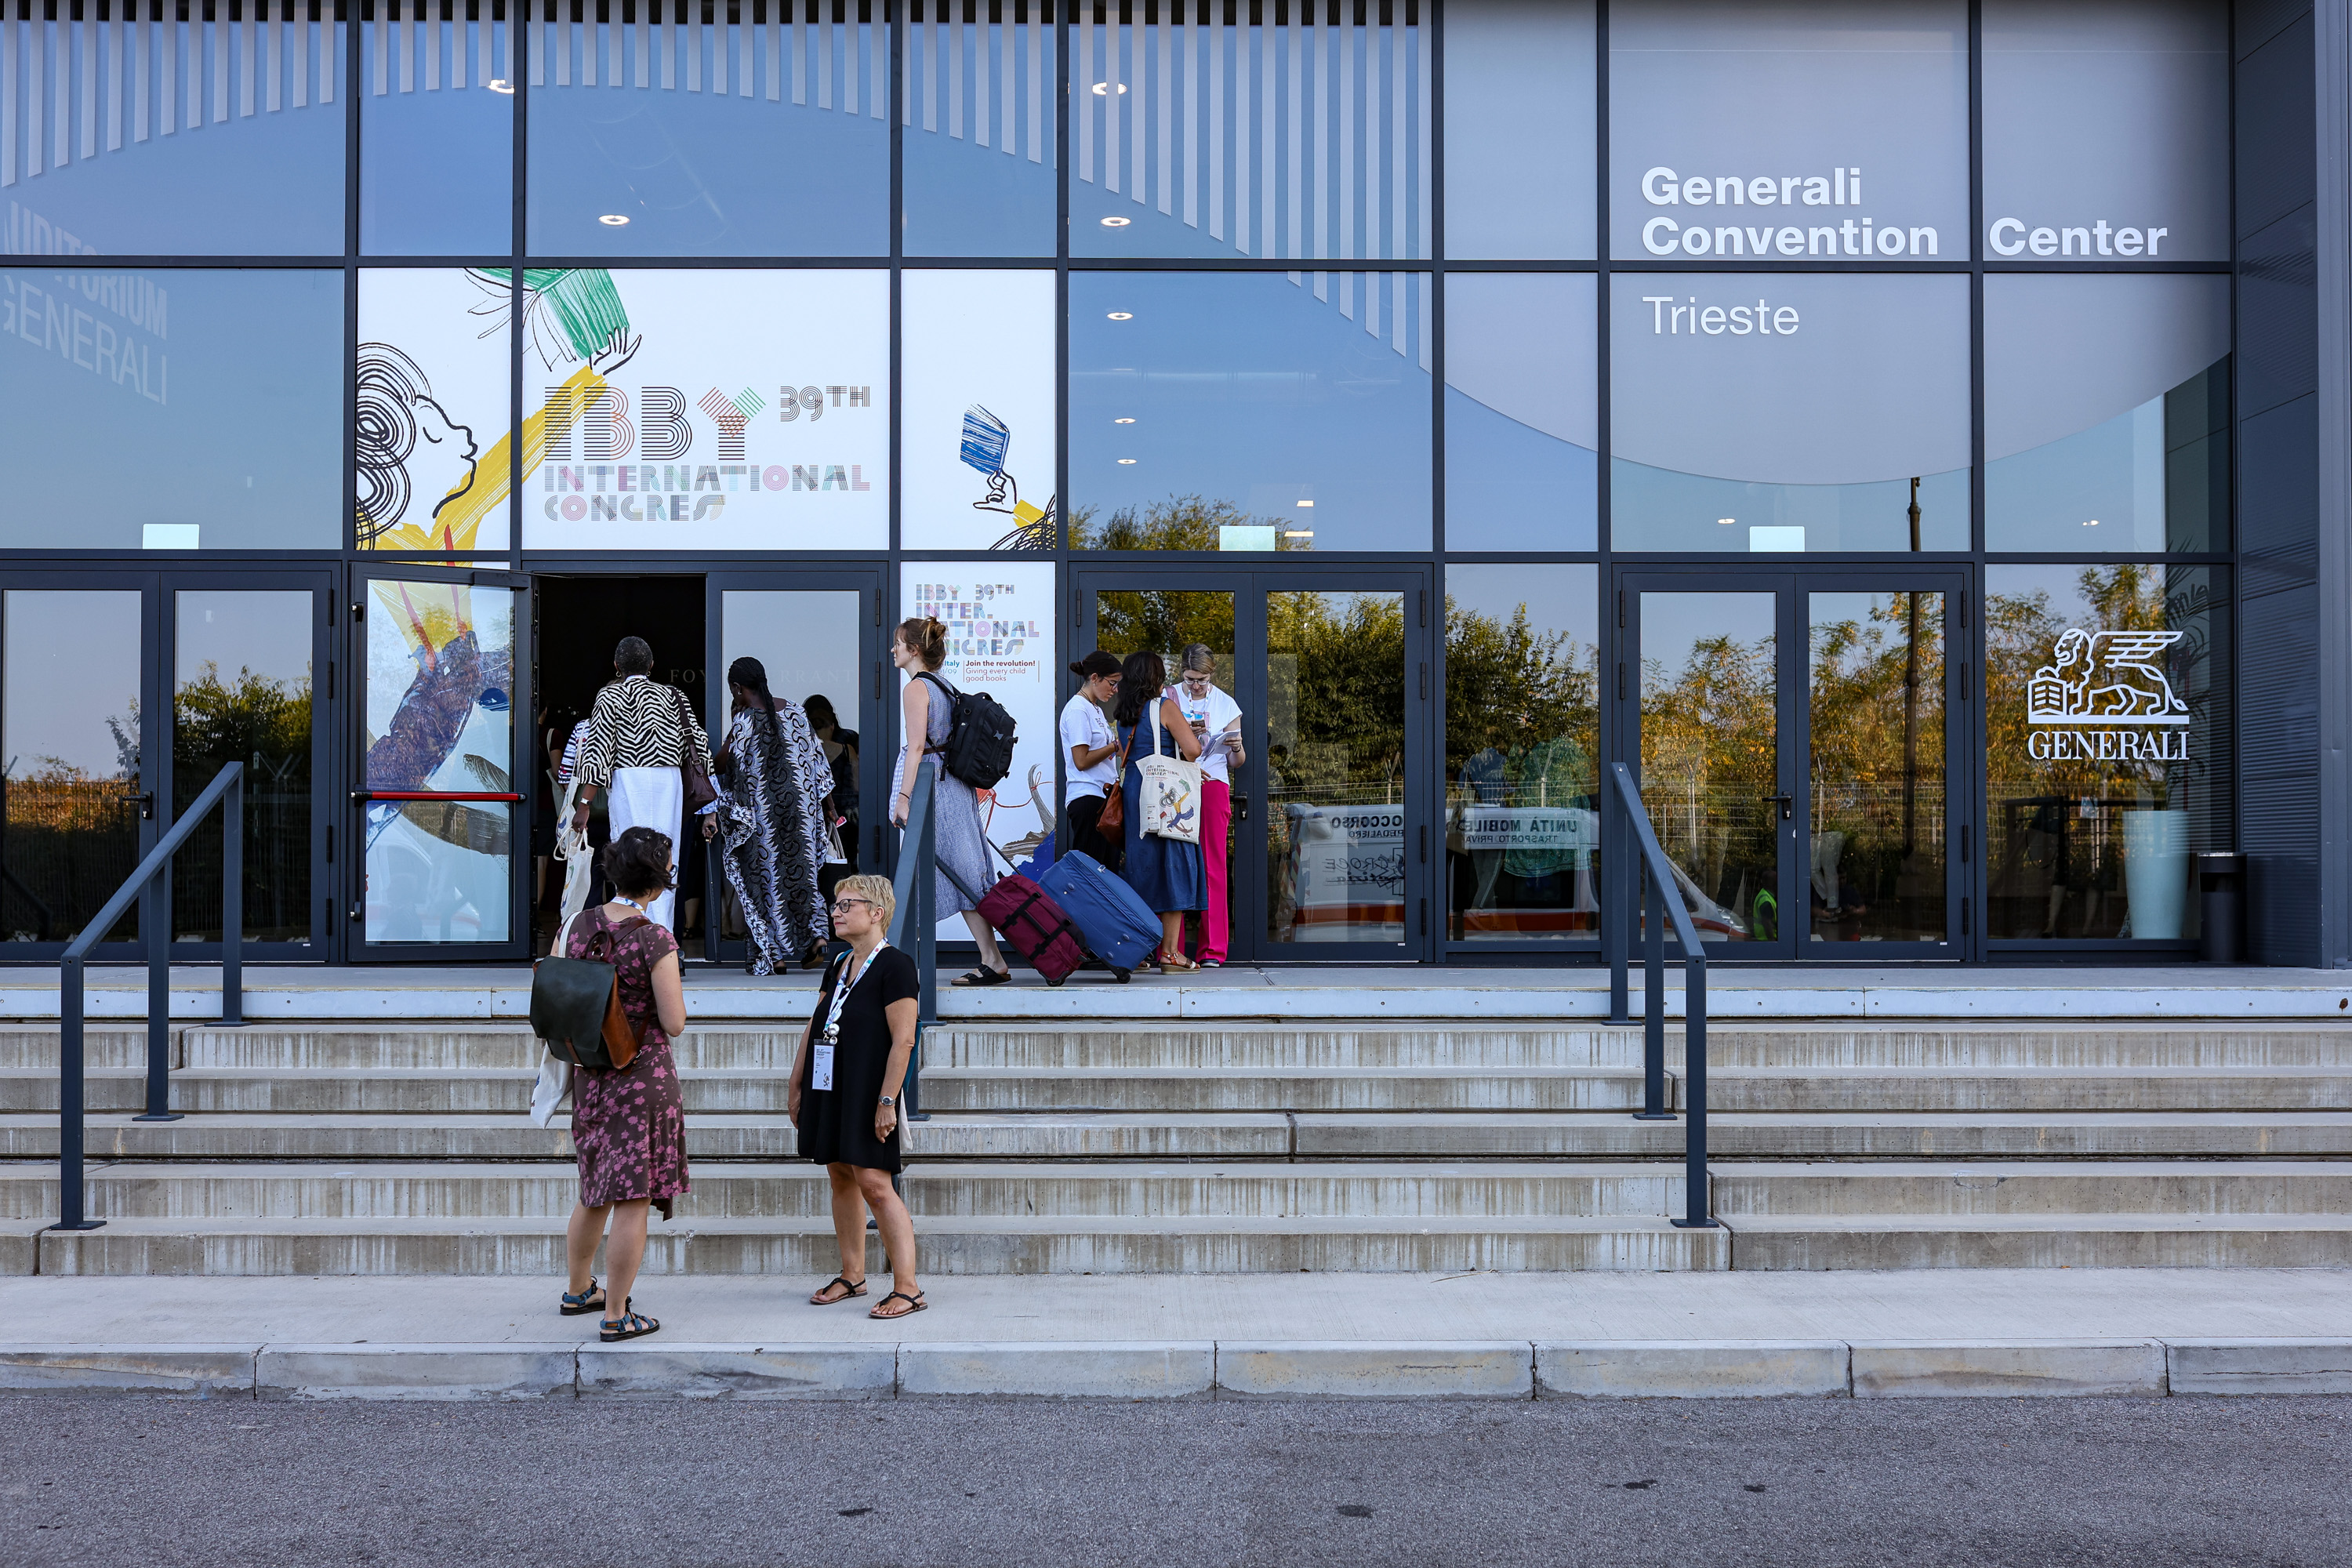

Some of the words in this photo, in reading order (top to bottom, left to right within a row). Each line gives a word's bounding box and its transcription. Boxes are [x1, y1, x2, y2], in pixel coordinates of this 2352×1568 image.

[1642, 167, 1861, 205] Generali
[1642, 216, 1940, 256] Convention
[1989, 217, 2167, 256] Center
[4, 201, 167, 339] UDITORIUM
[1642, 296, 1800, 336] Trieste
[544, 387, 766, 461] IBBY
[780, 386, 871, 422] 39TH
[544, 465, 870, 492] INTERNATIONAL
[916, 584, 962, 601] IBBY
[975, 584, 1014, 601] 39TH
[2028, 731, 2190, 760] GENERALI
